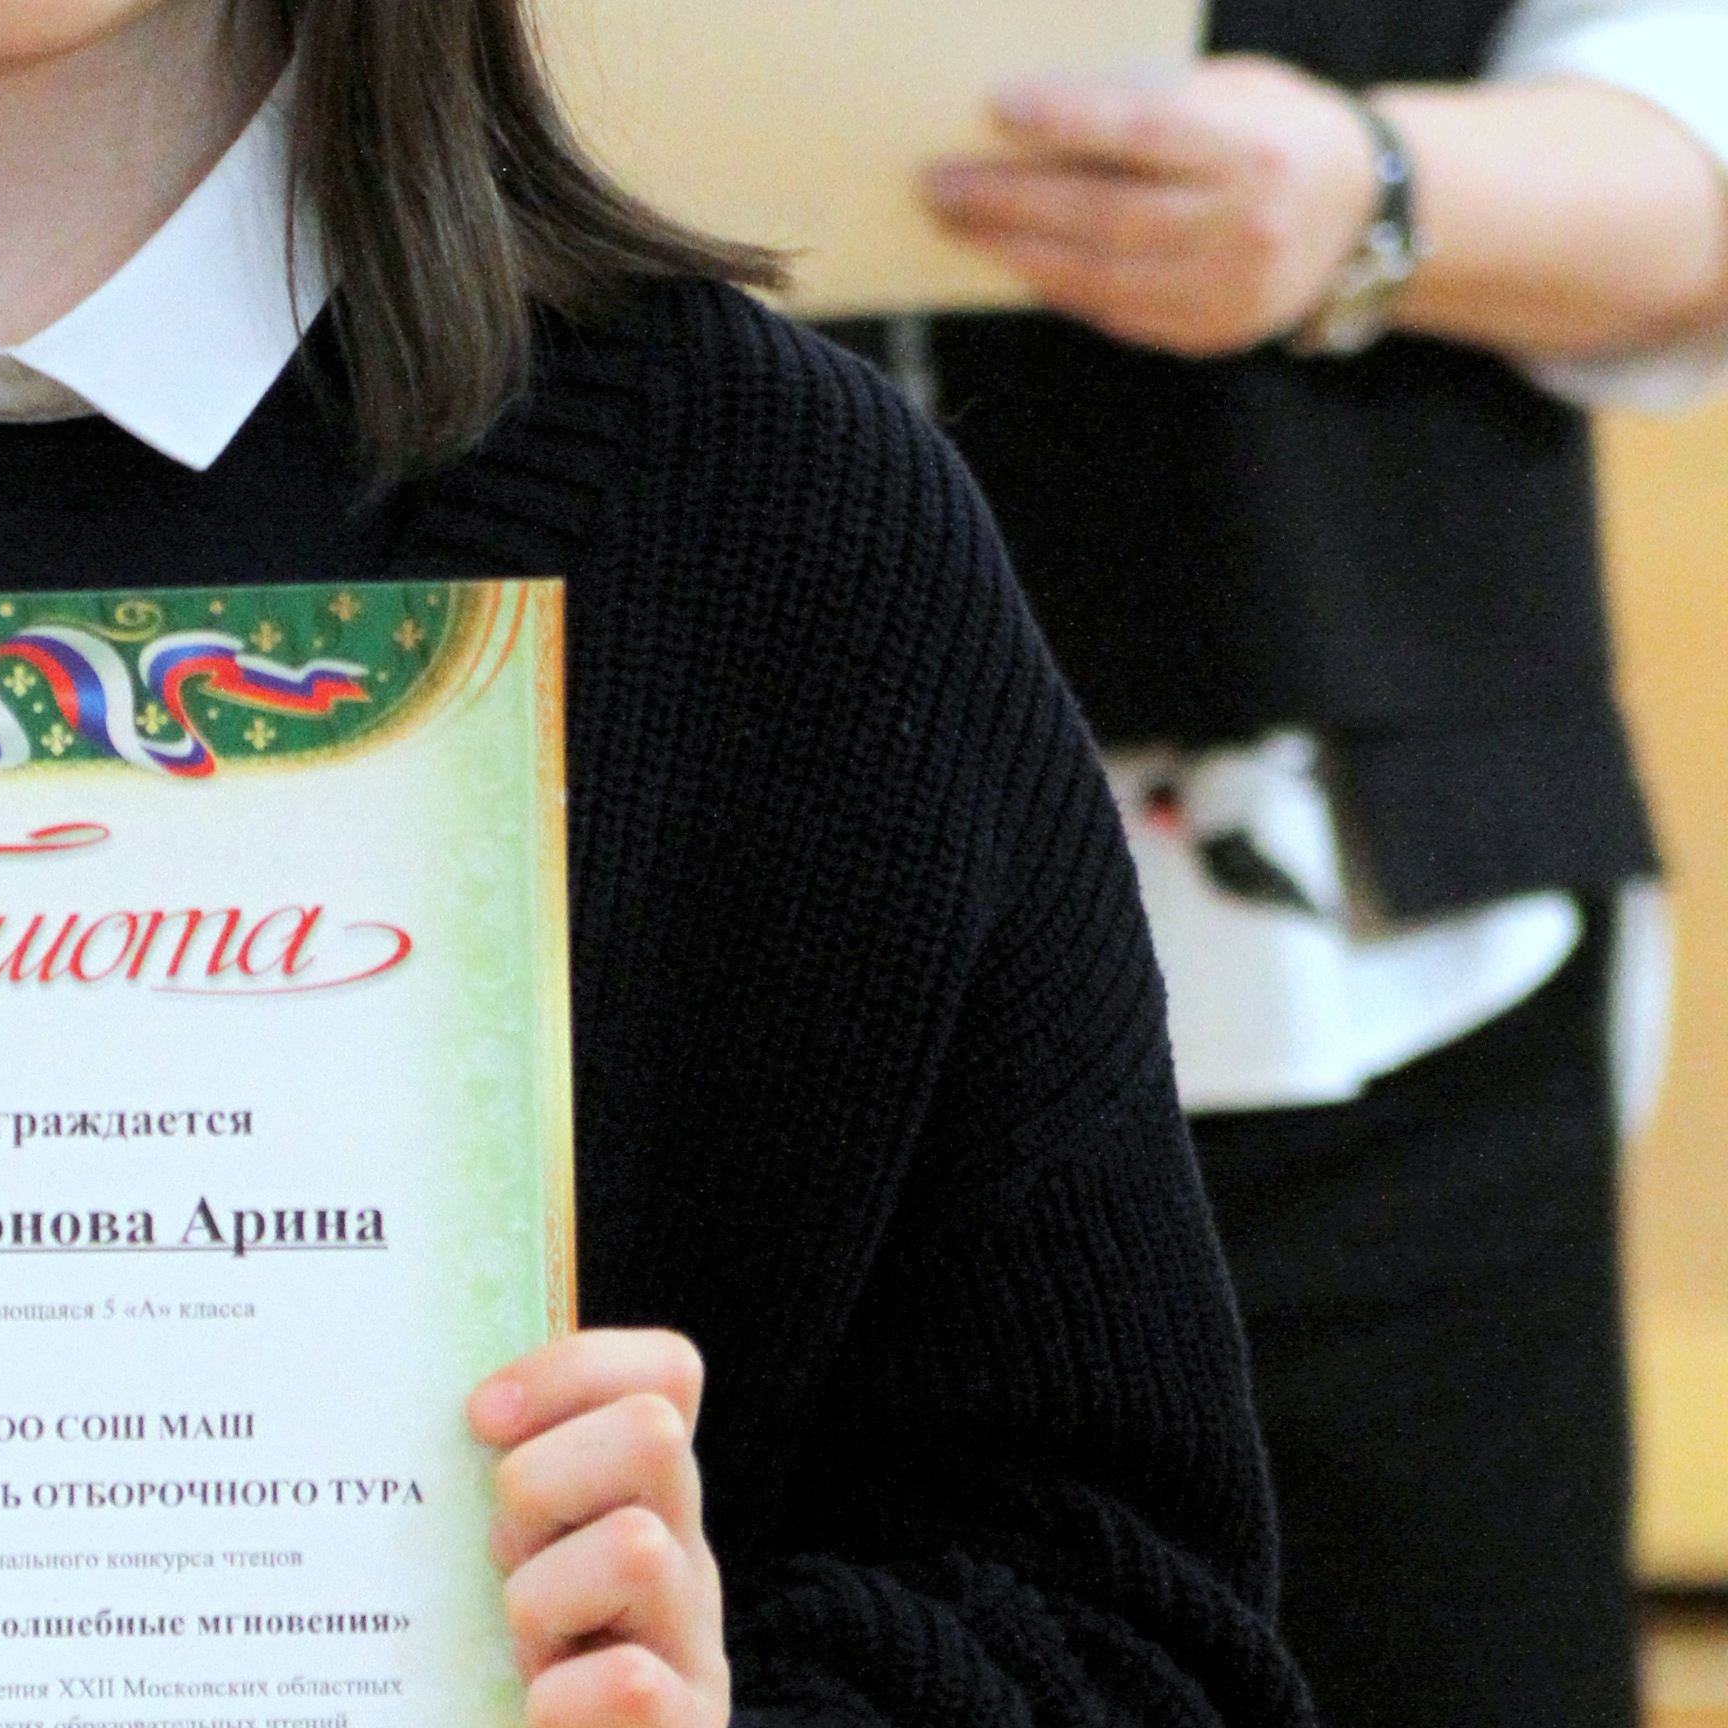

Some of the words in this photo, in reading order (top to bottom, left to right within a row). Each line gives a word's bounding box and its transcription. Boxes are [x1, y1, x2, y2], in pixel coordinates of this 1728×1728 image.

[180, 1195, 387, 1256] Арина
[103, 1297, 116, 1320] 5
[123, 1297, 172, 1320] «А»
[178, 1301, 257, 1320] класса
[55, 1413, 146, 1441] СОШ
[160, 1412, 255, 1440] МАШ
[32, 1479, 319, 1508] ОТБОРОЧНОГО
[328, 1477, 425, 1505] ТУРА
[106, 1551, 216, 1574] конкурса
[221, 1549, 305, 1569] чтецов
[197, 1612, 411, 1636] мгновения»
[122, 1675, 269, 1699] Московских
[275, 1673, 404, 1697] областных
